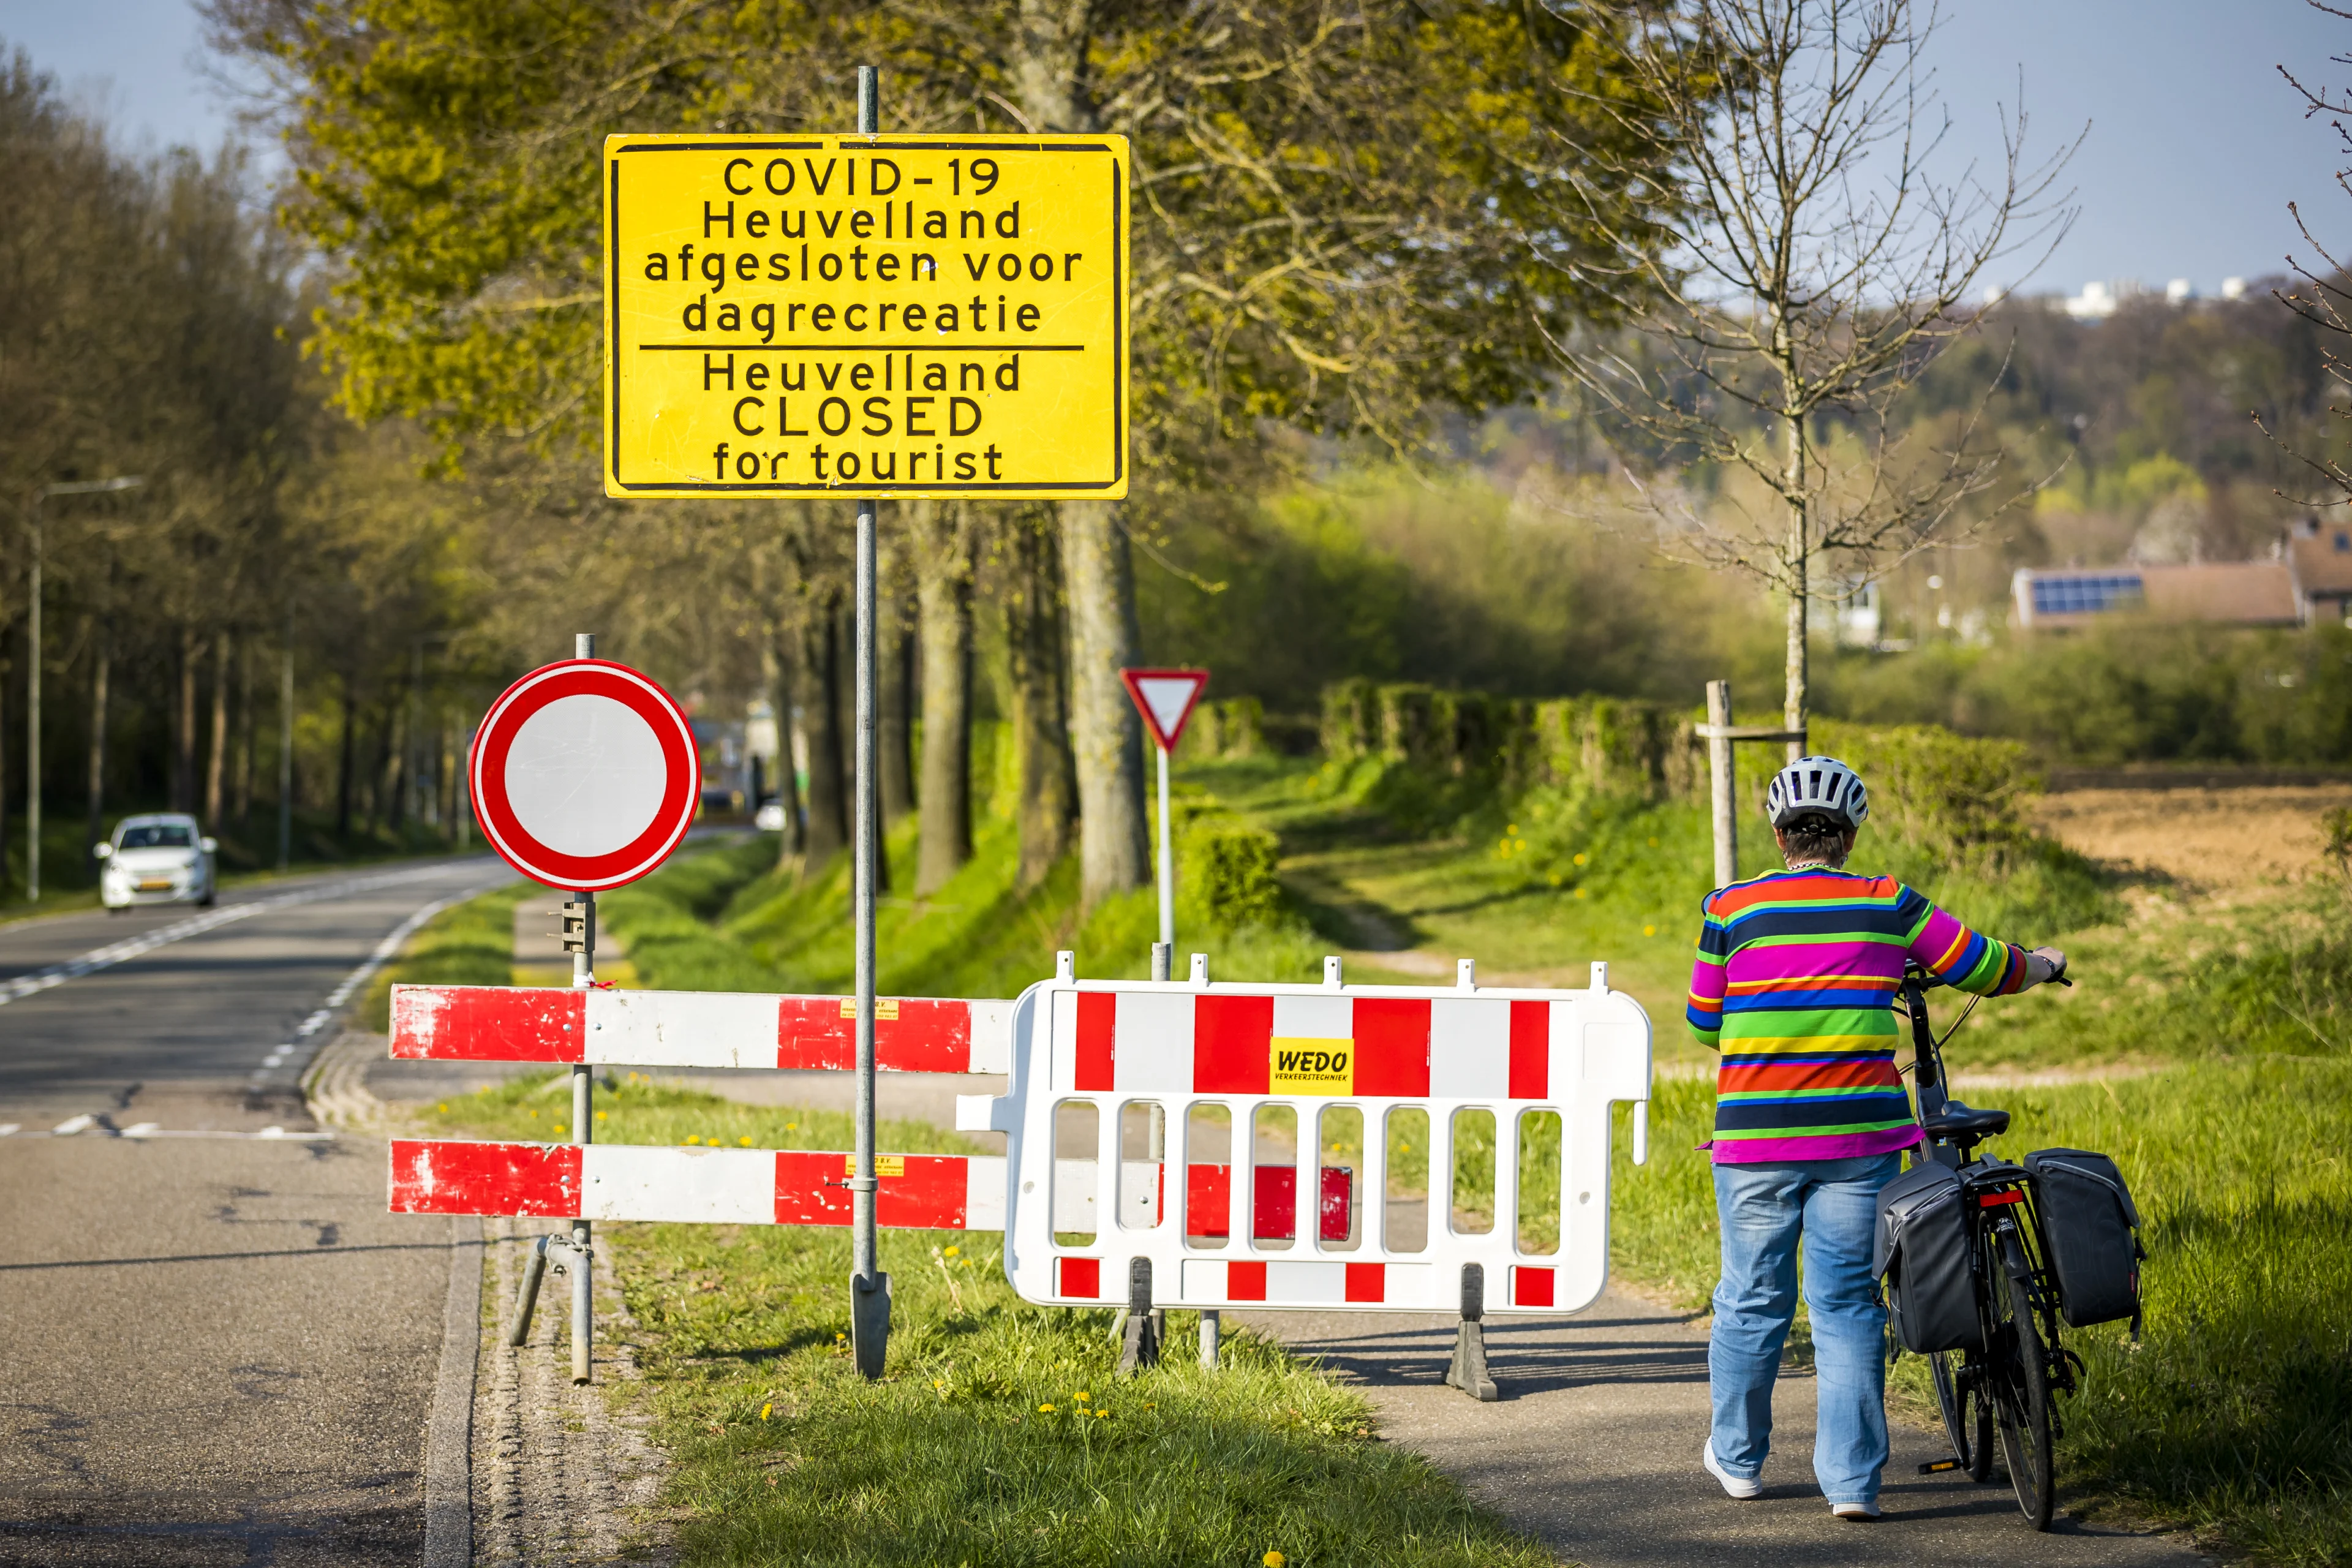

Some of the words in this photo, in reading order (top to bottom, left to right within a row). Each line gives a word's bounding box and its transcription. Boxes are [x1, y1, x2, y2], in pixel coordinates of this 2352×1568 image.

[724, 158, 999, 196] COVID-19
[704, 200, 1019, 239] Heuvelland
[644, 243, 937, 293] afgesloten
[963, 253, 1082, 282] voor
[683, 293, 1041, 344] dagrecreatie
[704, 353, 1019, 391] Heuvelland
[733, 396, 982, 437] CLOSED
[713, 443, 789, 480] for
[810, 443, 1002, 480] tourist
[1275, 1073, 1348, 1082] VERKEERSTECHNIEK
[1278, 1050, 1347, 1072] WEDO
